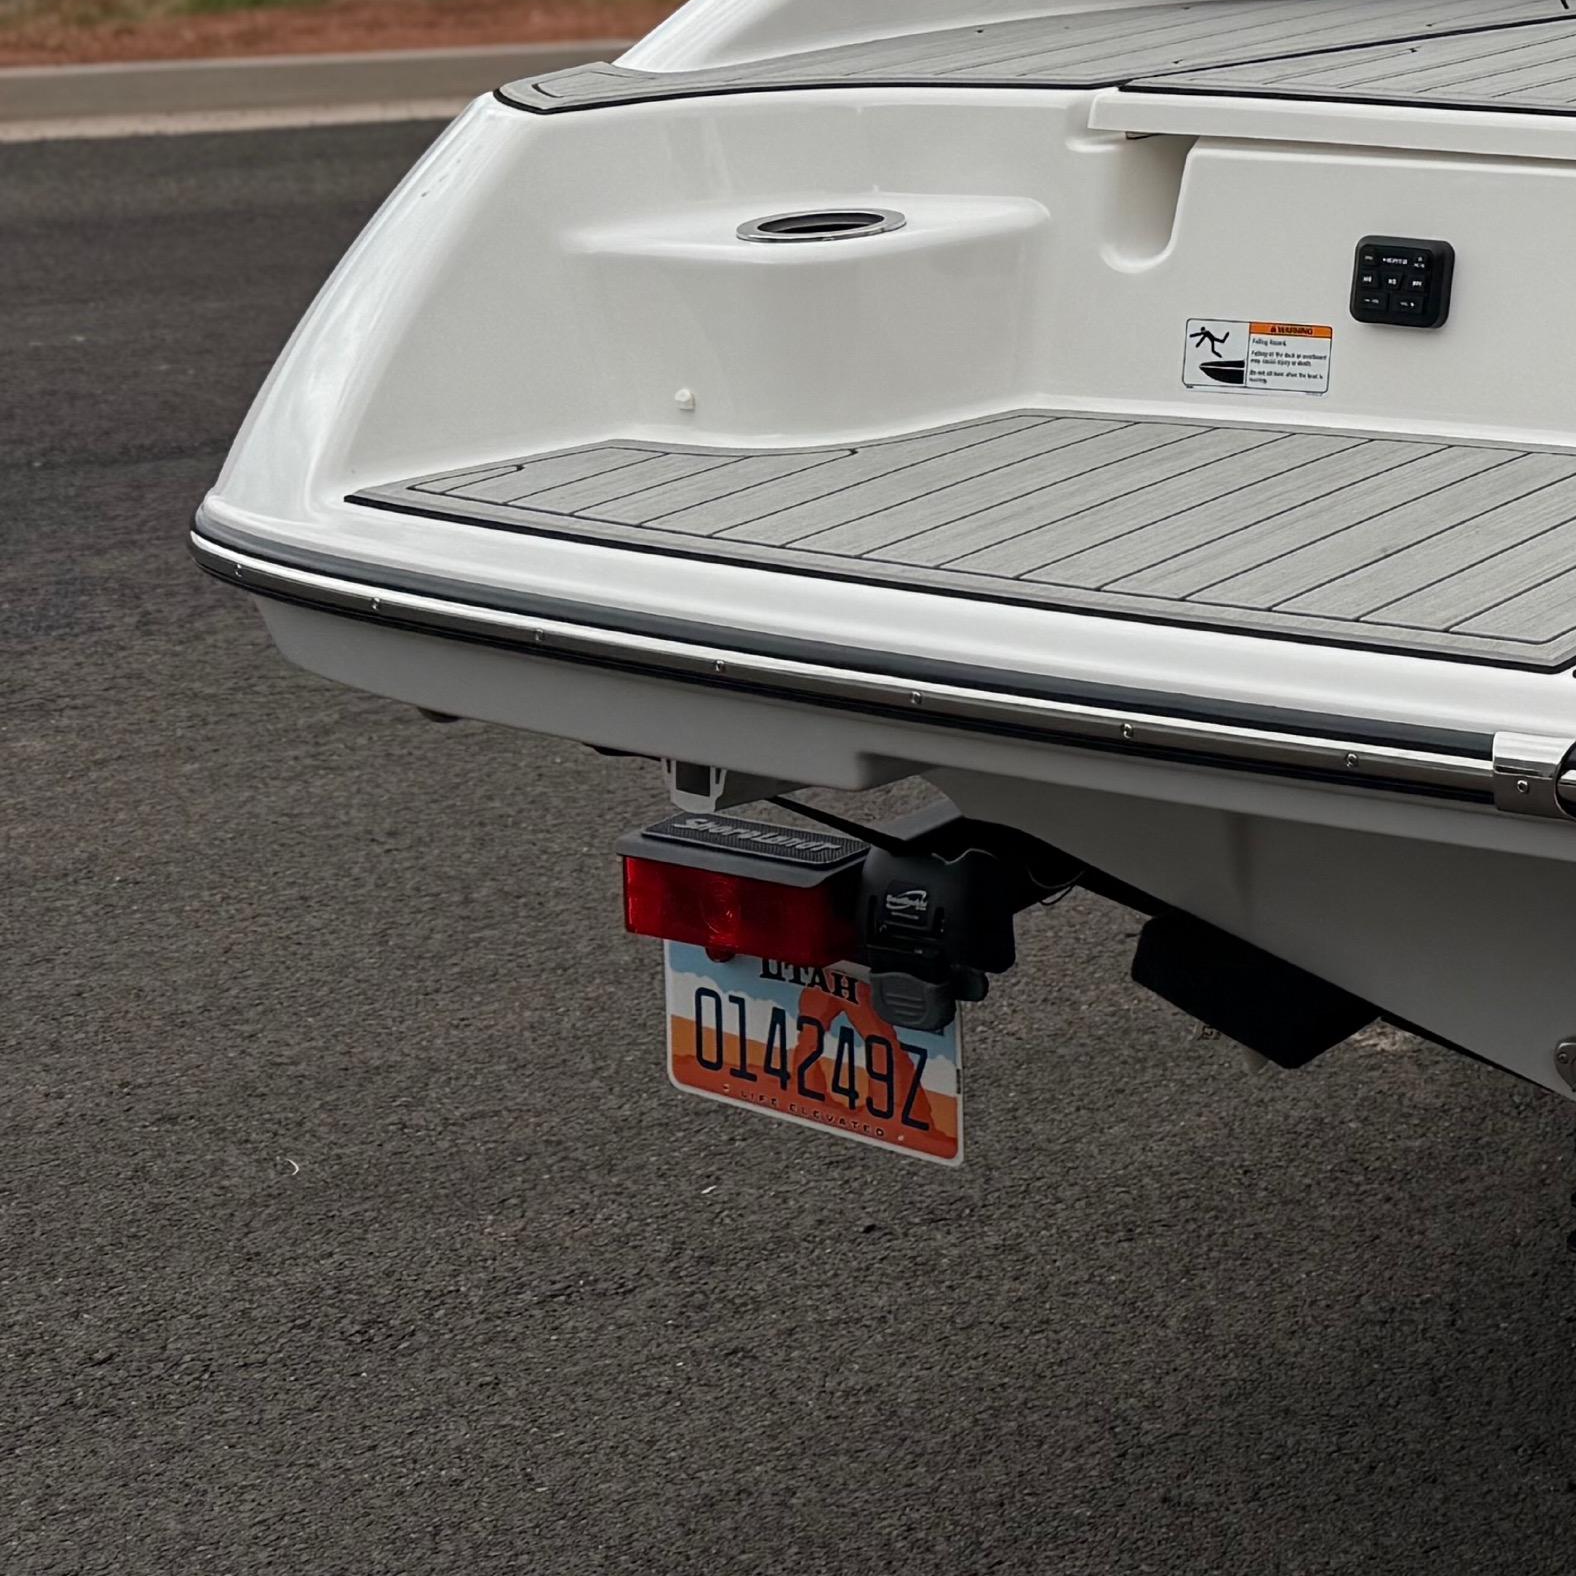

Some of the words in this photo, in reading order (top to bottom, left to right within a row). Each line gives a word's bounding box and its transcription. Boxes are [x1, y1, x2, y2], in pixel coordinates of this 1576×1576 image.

[759, 957, 860, 1004] UTAH
[694, 986, 930, 1131] 014249Z
[739, 1091, 778, 1108] LIFE
[788, 1103, 887, 1138] ELEVATED
